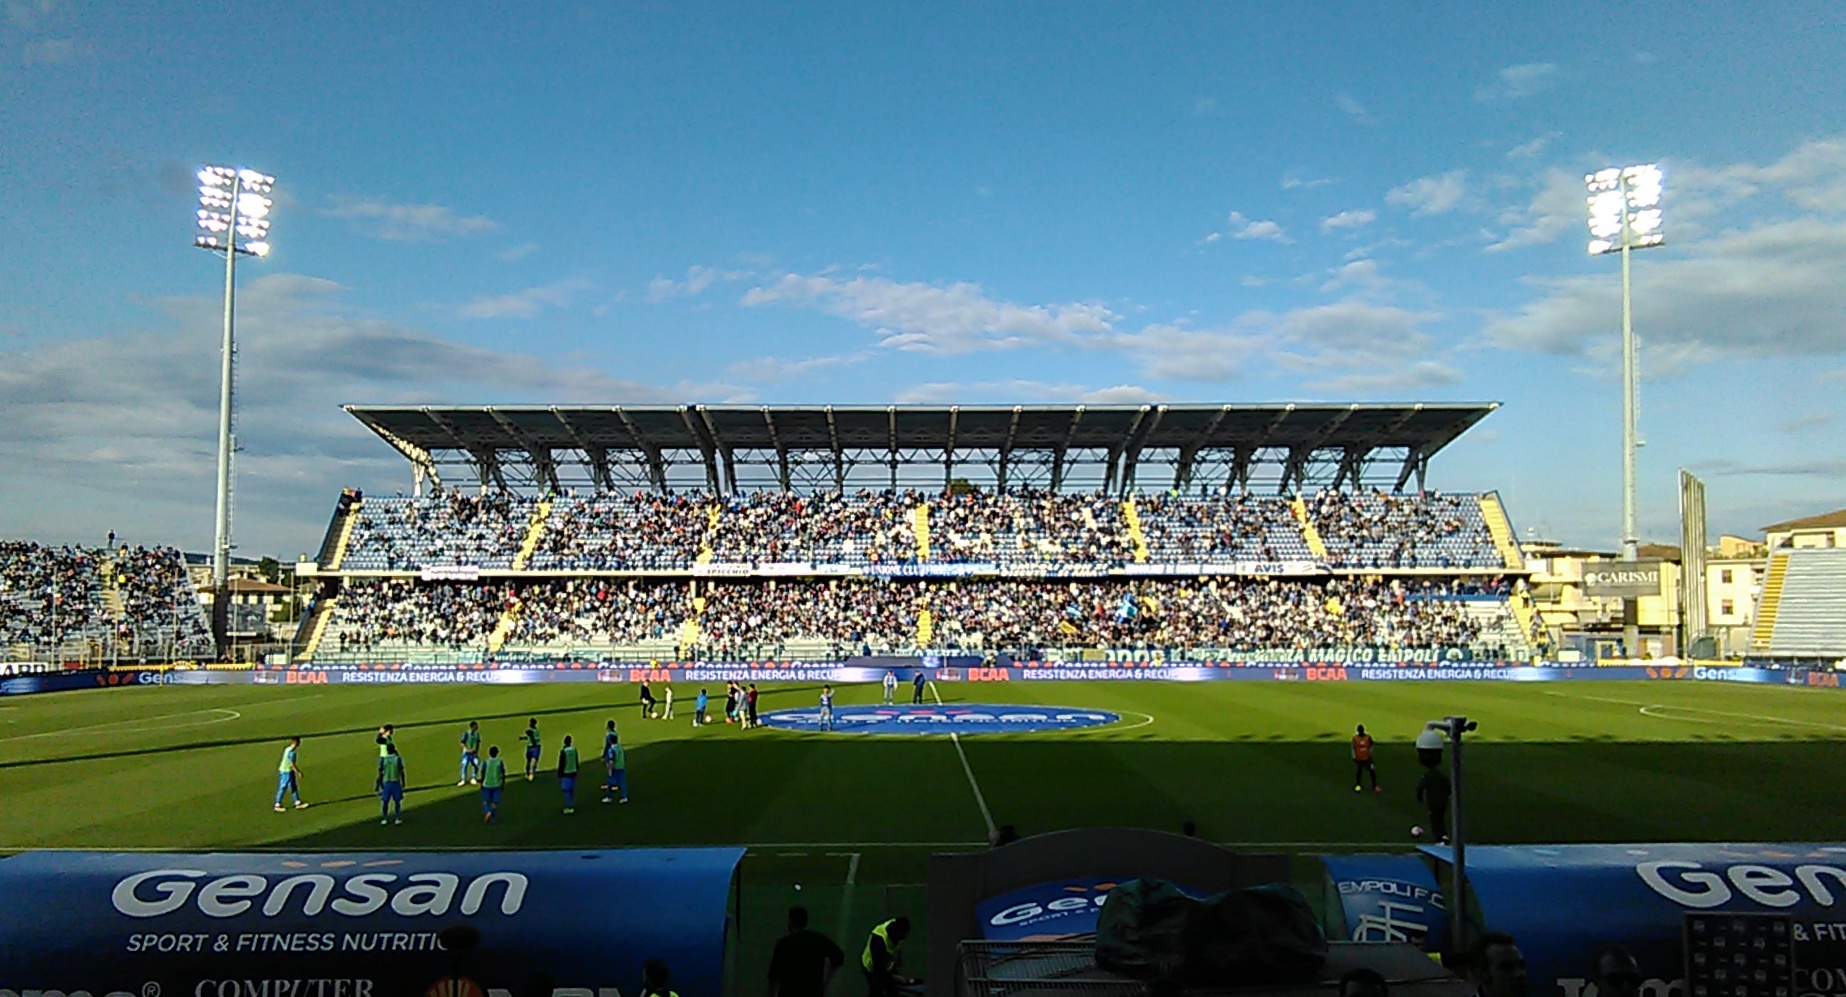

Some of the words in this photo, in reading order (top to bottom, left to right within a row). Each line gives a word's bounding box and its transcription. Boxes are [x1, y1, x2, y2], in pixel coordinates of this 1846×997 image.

[1254, 564, 1285, 573] AVIS
[1597, 570, 1659, 585] CARISMI
[286, 670, 328, 684] BCAA
[342, 671, 407, 683] RESISTENZA
[409, 671, 456, 683] ENERGIA
[629, 669, 671, 682] BCAA
[685, 670, 749, 681] RESISTENZA
[751, 670, 796, 681] ENERGIA
[968, 668, 1009, 681] BCAA
[1023, 669, 1087, 680] RESISTENZA
[1088, 669, 1133, 680] ENERGIA
[1306, 667, 1347, 681] BCAA
[1361, 669, 1425, 680] RESISTENZA
[1427, 669, 1471, 680] ENERGIA
[112, 870, 529, 917] Gensan
[1338, 881, 1411, 897] EMPOLI
[990, 894, 1108, 926] Ge
[127, 933, 209, 952] SPORT
[213, 934, 230, 952] &
[236, 934, 335, 952] FITNESS
[341, 932, 449, 952] NUTRITI
